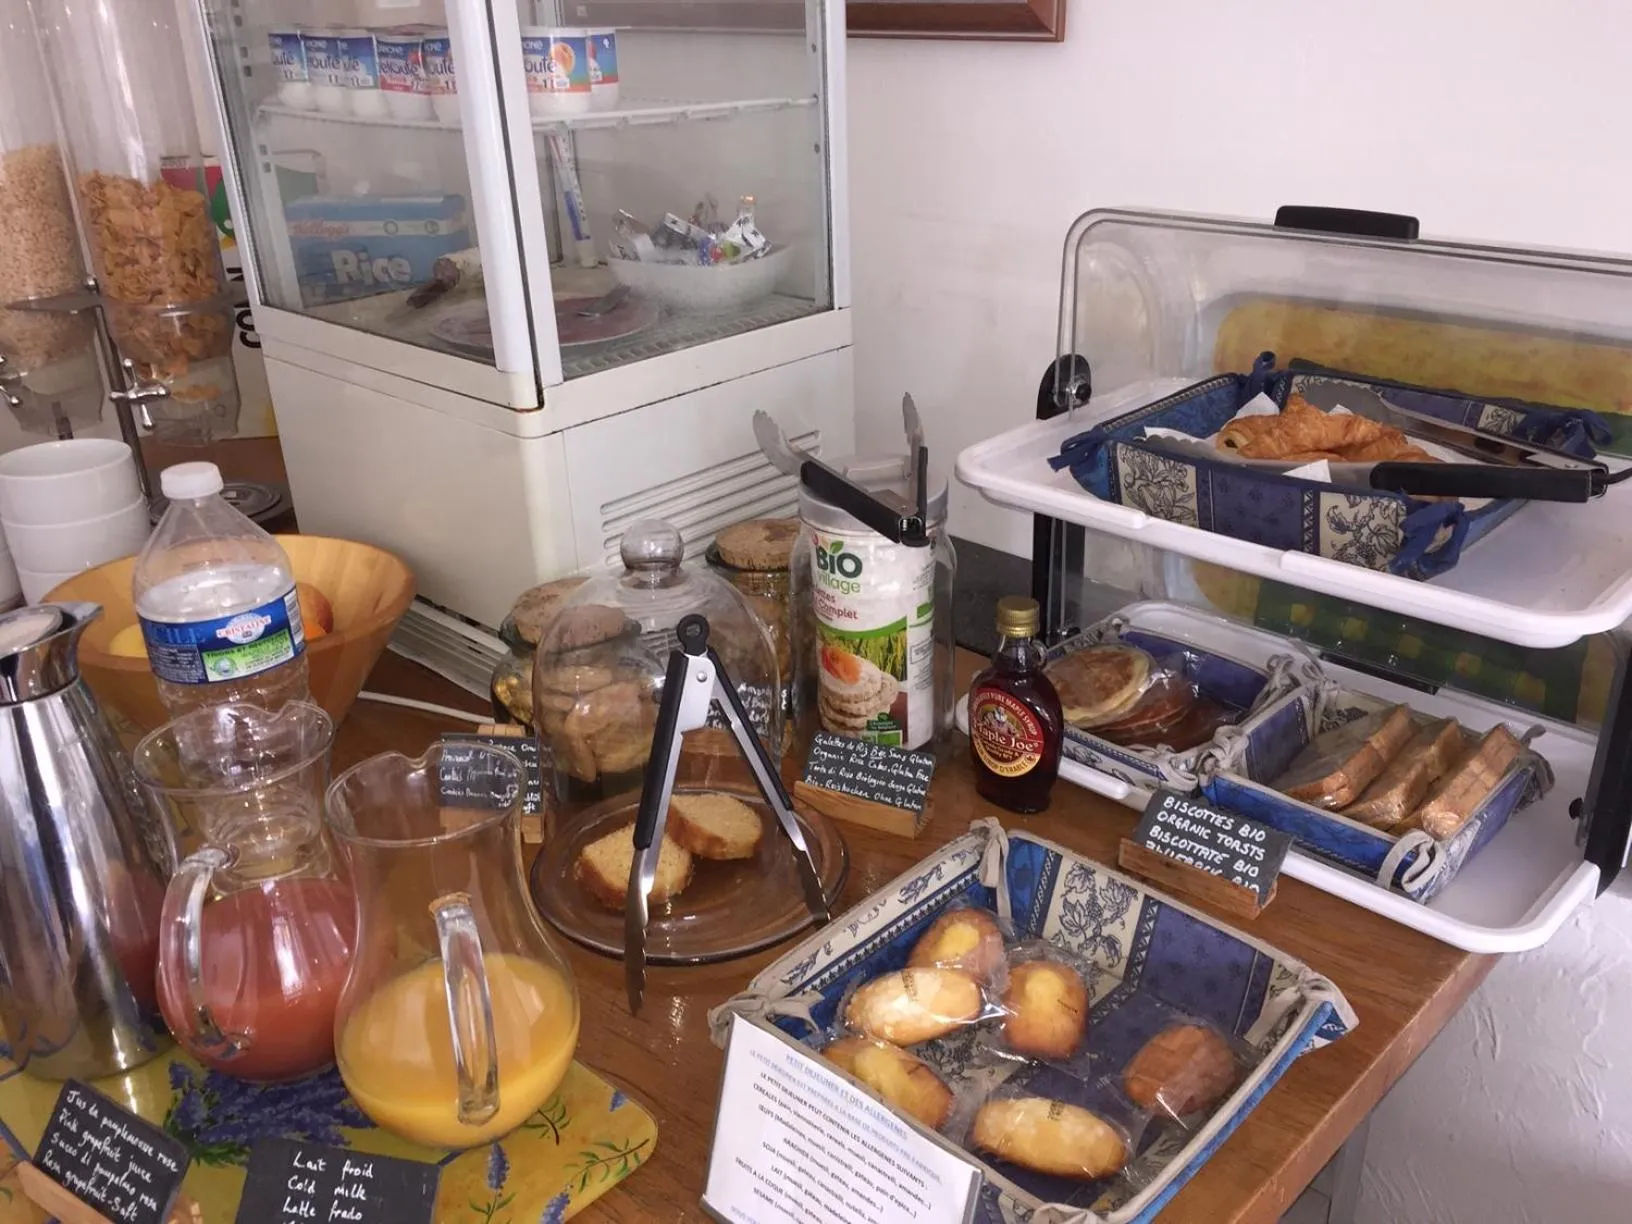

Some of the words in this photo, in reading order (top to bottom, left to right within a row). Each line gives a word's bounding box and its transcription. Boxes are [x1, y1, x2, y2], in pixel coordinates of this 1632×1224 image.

[330, 250, 412, 286] Rice
[816, 551, 863, 578] BIO
[1011, 737, 1035, 752] Joe
[1163, 796, 1236, 831] BISCOTTES
[1238, 824, 1266, 842] BIO
[1157, 810, 1211, 840] ORGANIC
[1216, 833, 1266, 861] TOASTS
[1233, 859, 1259, 877] BIO
[67, 1090, 86, 1109] Jus
[157, 1152, 178, 1172] rose
[850, 1131, 860, 1143] LES
[341, 1160, 374, 1180] froid
[288, 1175, 316, 1194] Cold
[283, 1196, 316, 1217] Latte
